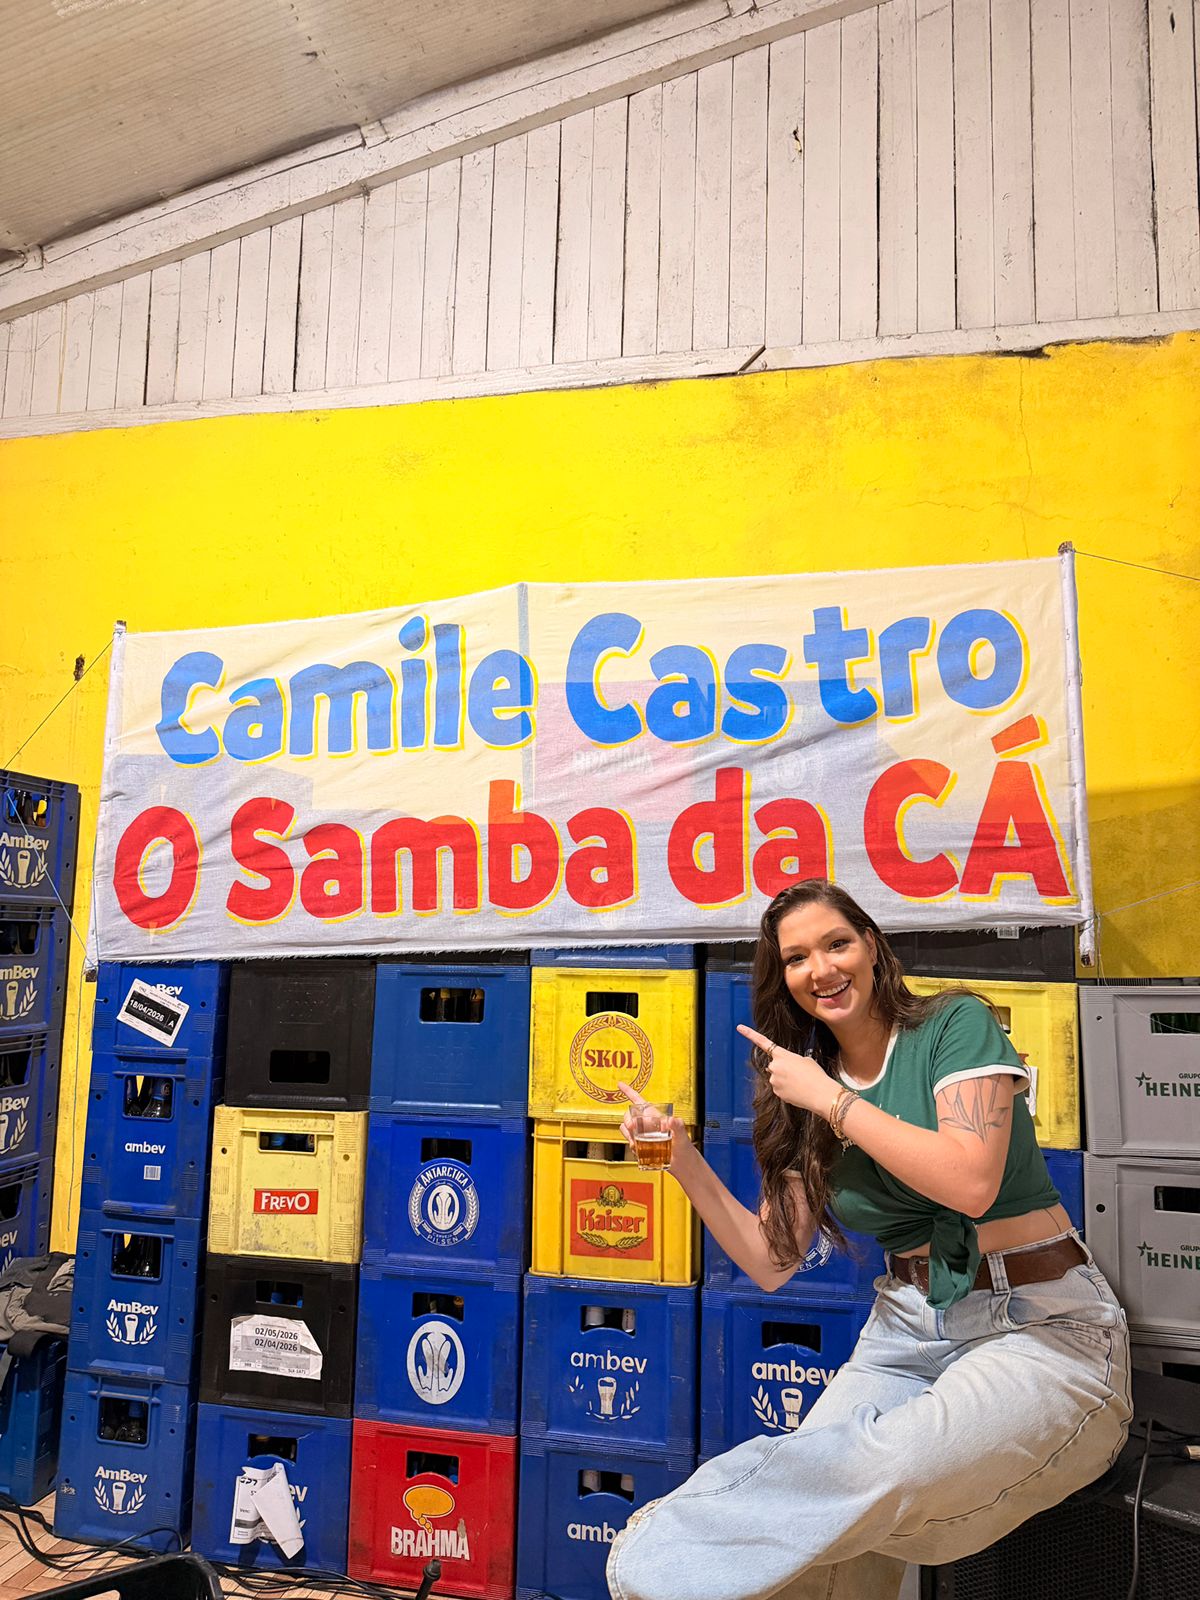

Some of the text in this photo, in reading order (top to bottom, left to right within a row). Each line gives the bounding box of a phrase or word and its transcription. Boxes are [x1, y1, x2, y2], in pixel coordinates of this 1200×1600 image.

[156, 606, 1028, 767] Camile Castro
[113, 714, 1078, 935] O Samba da CÁ
[0, 832, 49, 850] AmBev
[150, 982, 183, 996] Bev
[129, 999, 165, 1022] 18/04/2026
[168, 1020, 176, 1028] A
[584, 1049, 638, 1069] SKOL
[0, 1096, 29, 1112] Bev
[125, 1141, 166, 1154] ambev
[420, 1166, 469, 1187] ANTARCTICA
[579, 1207, 645, 1233] Kaiser
[0, 1230, 18, 1248] ev
[107, 1299, 159, 1315] AmBev
[255, 1327, 298, 1341] 02/05/2026
[254, 1338, 298, 1352] 02/04/2026
[570, 1350, 647, 1374] ambev
[751, 1360, 837, 1386] ambev
[95, 1466, 147, 1483] AmBev
[391, 1526, 470, 1561] BRAHMA
